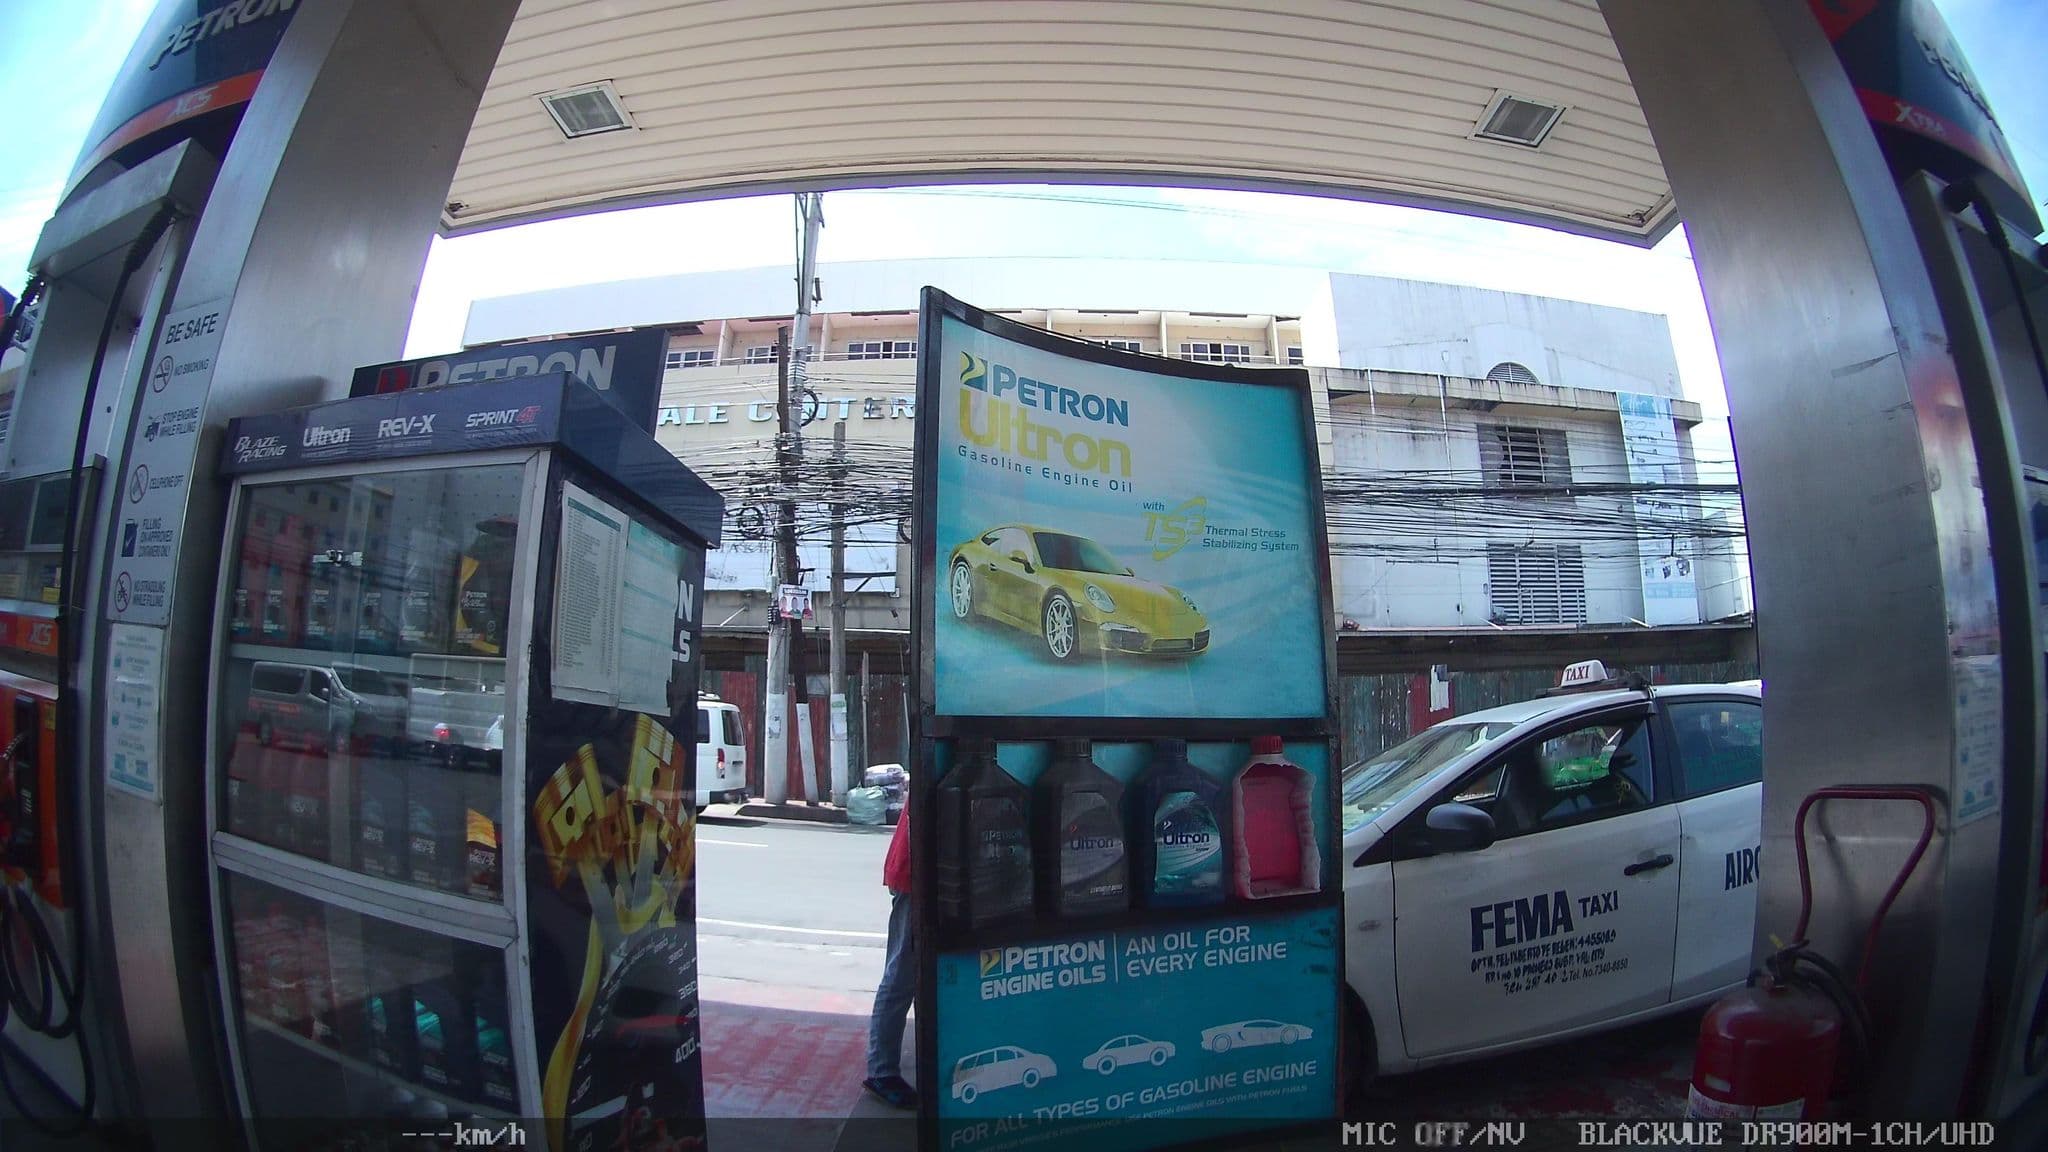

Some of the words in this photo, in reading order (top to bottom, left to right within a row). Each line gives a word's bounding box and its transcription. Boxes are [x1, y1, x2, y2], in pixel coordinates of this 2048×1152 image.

[165, 322, 184, 344] BE
[185, 313, 219, 340] SAFE
[992, 364, 1128, 427] PETRON
[749, 396, 915, 423] CNTER
[303, 426, 350, 447] Ultron
[378, 413, 437, 438] REV-X
[959, 388, 1132, 477] Ultron
[234, 435, 281, 453] BLAZE
[238, 445, 287, 463] RACING
[958, 445, 1032, 475] Gasoline
[1042, 467, 1099, 487] Engine
[1109, 479, 1132, 493] Oil
[1143, 502, 1165, 512] with
[1205, 525, 1248, 537] Thermal
[1251, 528, 1286, 538] Stress
[1202, 538, 1258, 552] Stabilizing
[1261, 541, 1299, 552] System
[1566, 665, 1590, 681] TAXI
[1071, 836, 1114, 850] Ultron
[1163, 832, 1210, 846] Ultron
[1470, 890, 1574, 953] FEMA
[1578, 890, 1619, 919] TAXI
[1005, 940, 1105, 973] PETRON
[1125, 935, 1156, 957] AN
[1163, 932, 1198, 951] OIL
[1205, 925, 1250, 947] FOR
[980, 970, 1054, 1000] ENGINE
[1058, 964, 1106, 987] OILS
[1127, 951, 1198, 978] EVERY
[1203, 941, 1287, 967] ENGINE
[675, 1036, 696, 1064] 400
[951, 1122, 989, 1149] FOR
[994, 1112, 1029, 1136] ALL
[1032, 1097, 1100, 1125] TYPES
[1105, 1091, 1135, 1111] OF
[1139, 1071, 1238, 1104] GASOLINE
[1243, 1060, 1317, 1085] ENGINE
